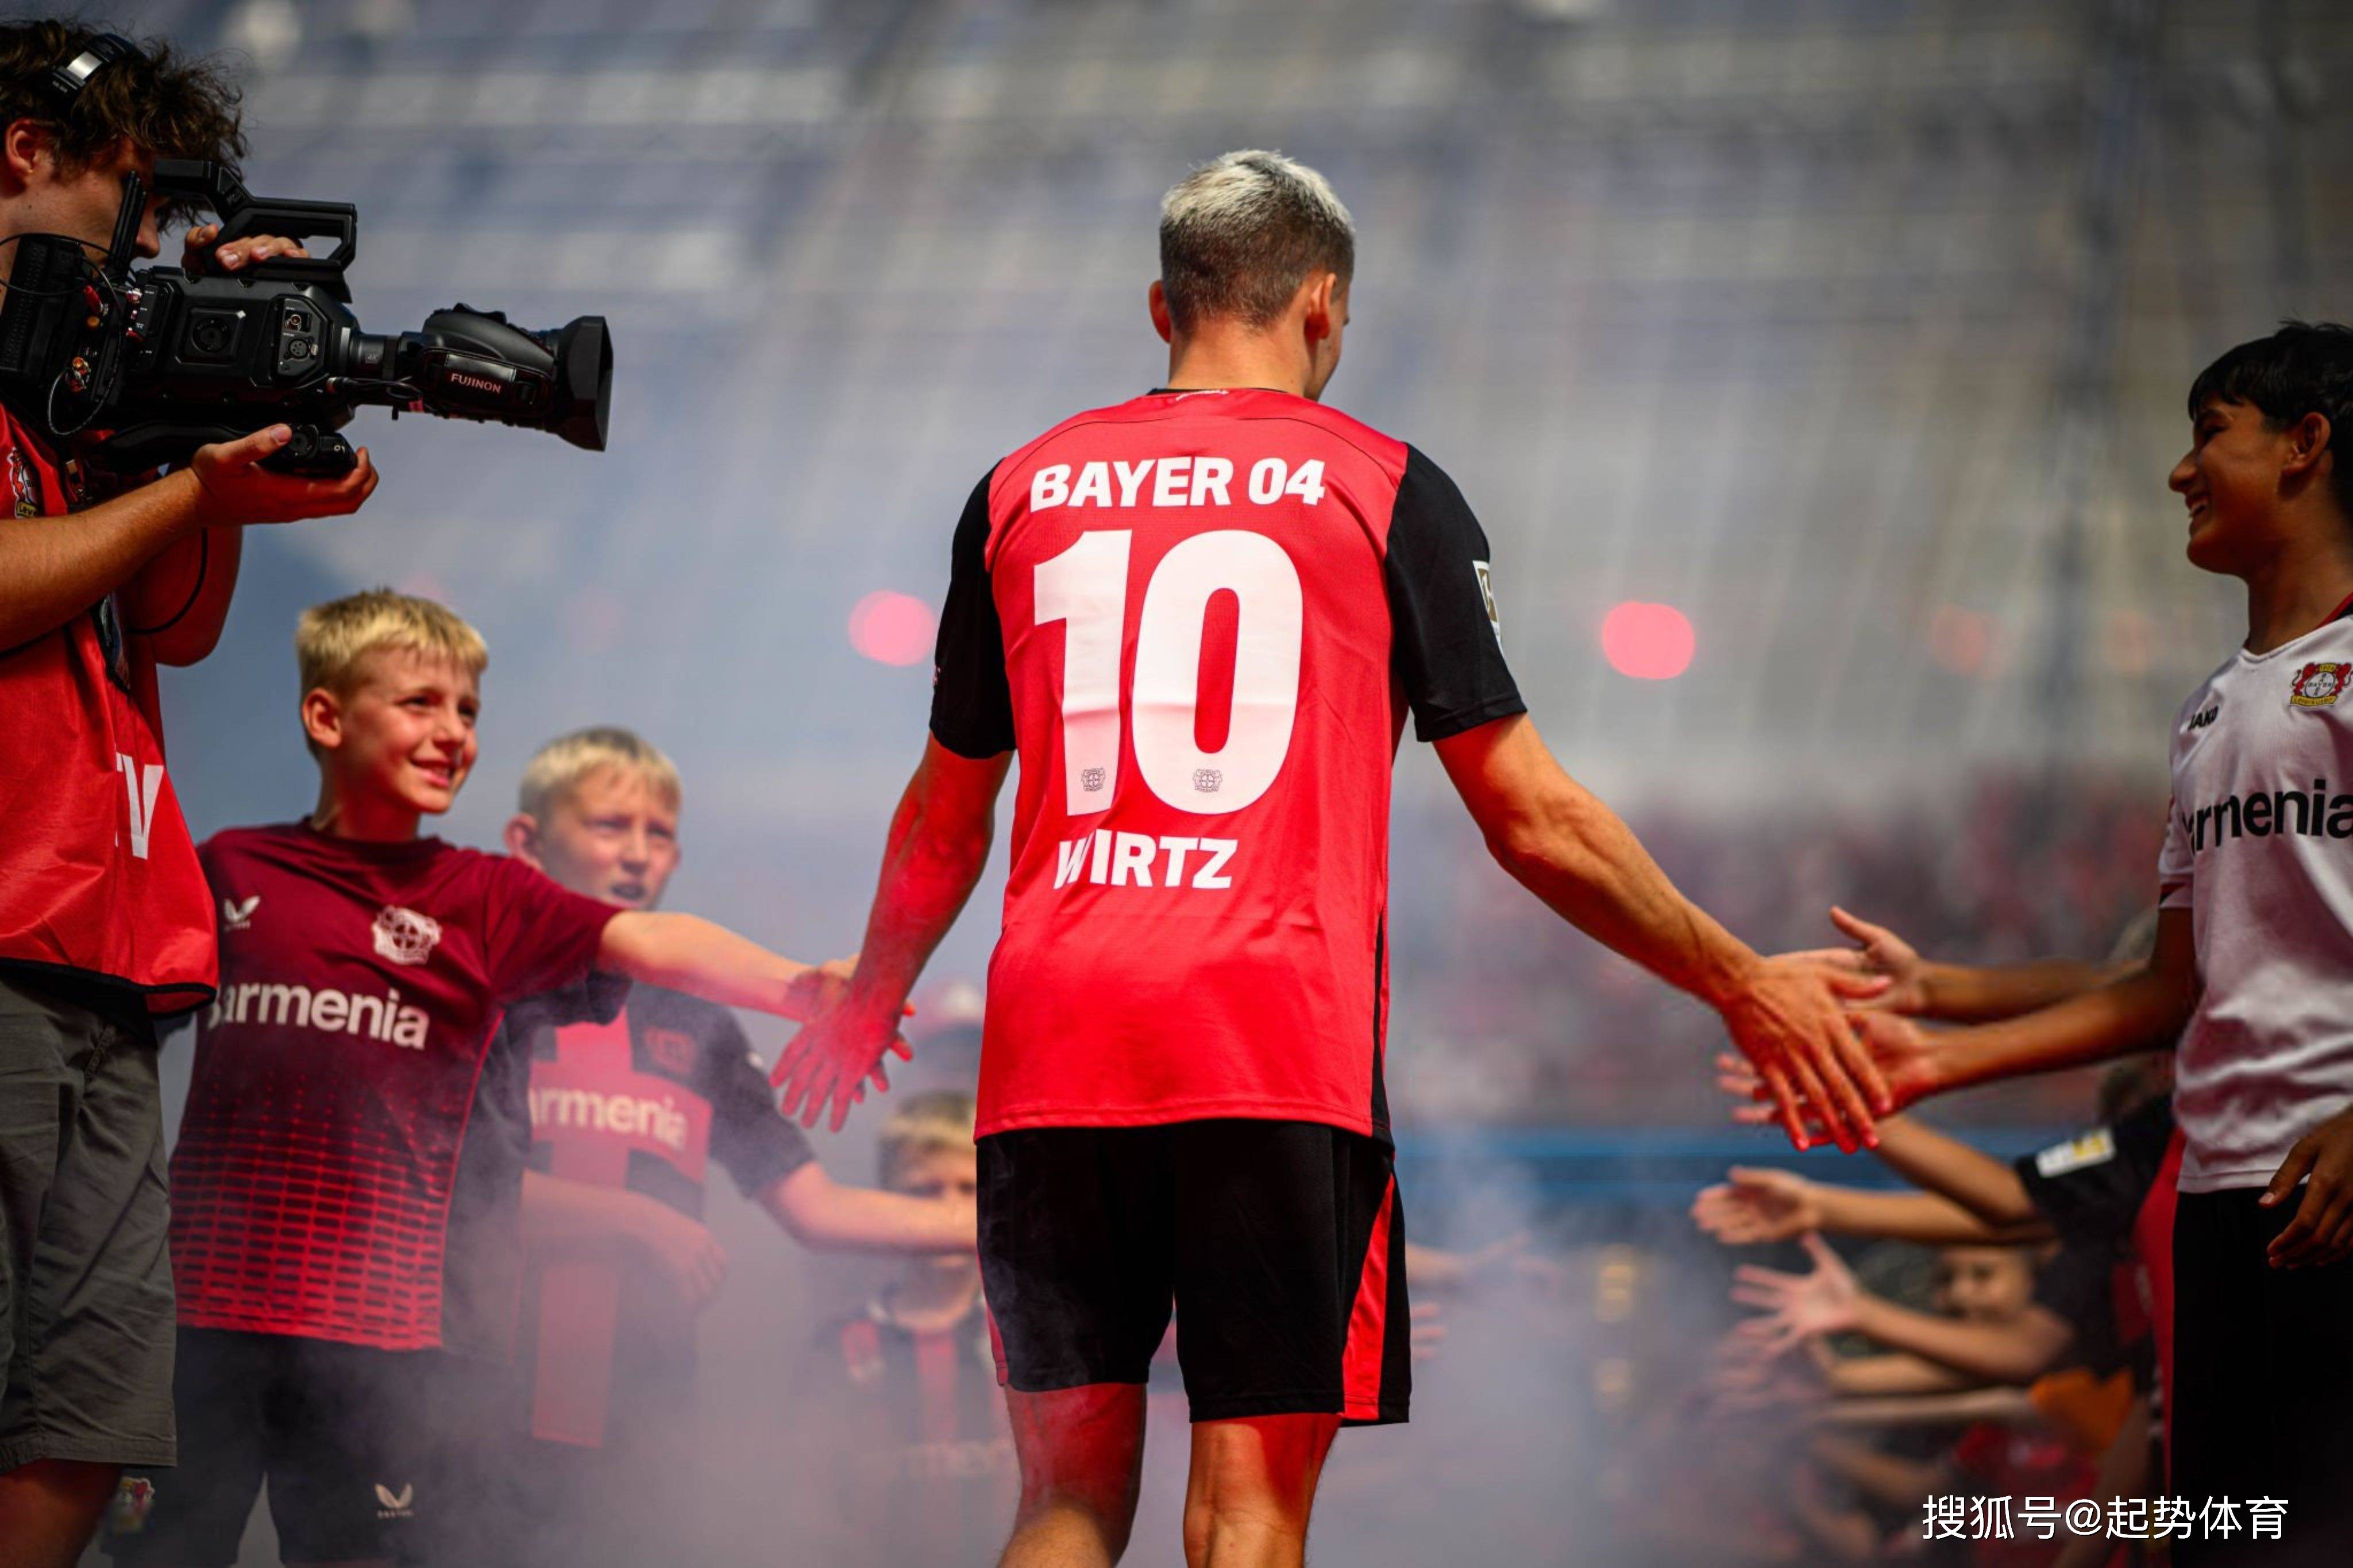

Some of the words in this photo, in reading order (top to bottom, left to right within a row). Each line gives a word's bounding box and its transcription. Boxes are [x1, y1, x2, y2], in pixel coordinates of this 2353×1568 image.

[451, 373, 501, 394] FUJINON
[1031, 457, 1233, 512] BAYER
[1248, 458, 1325, 506] 04
[1034, 528, 1303, 817] 10
[1053, 829, 1239, 889] WIRTZ
